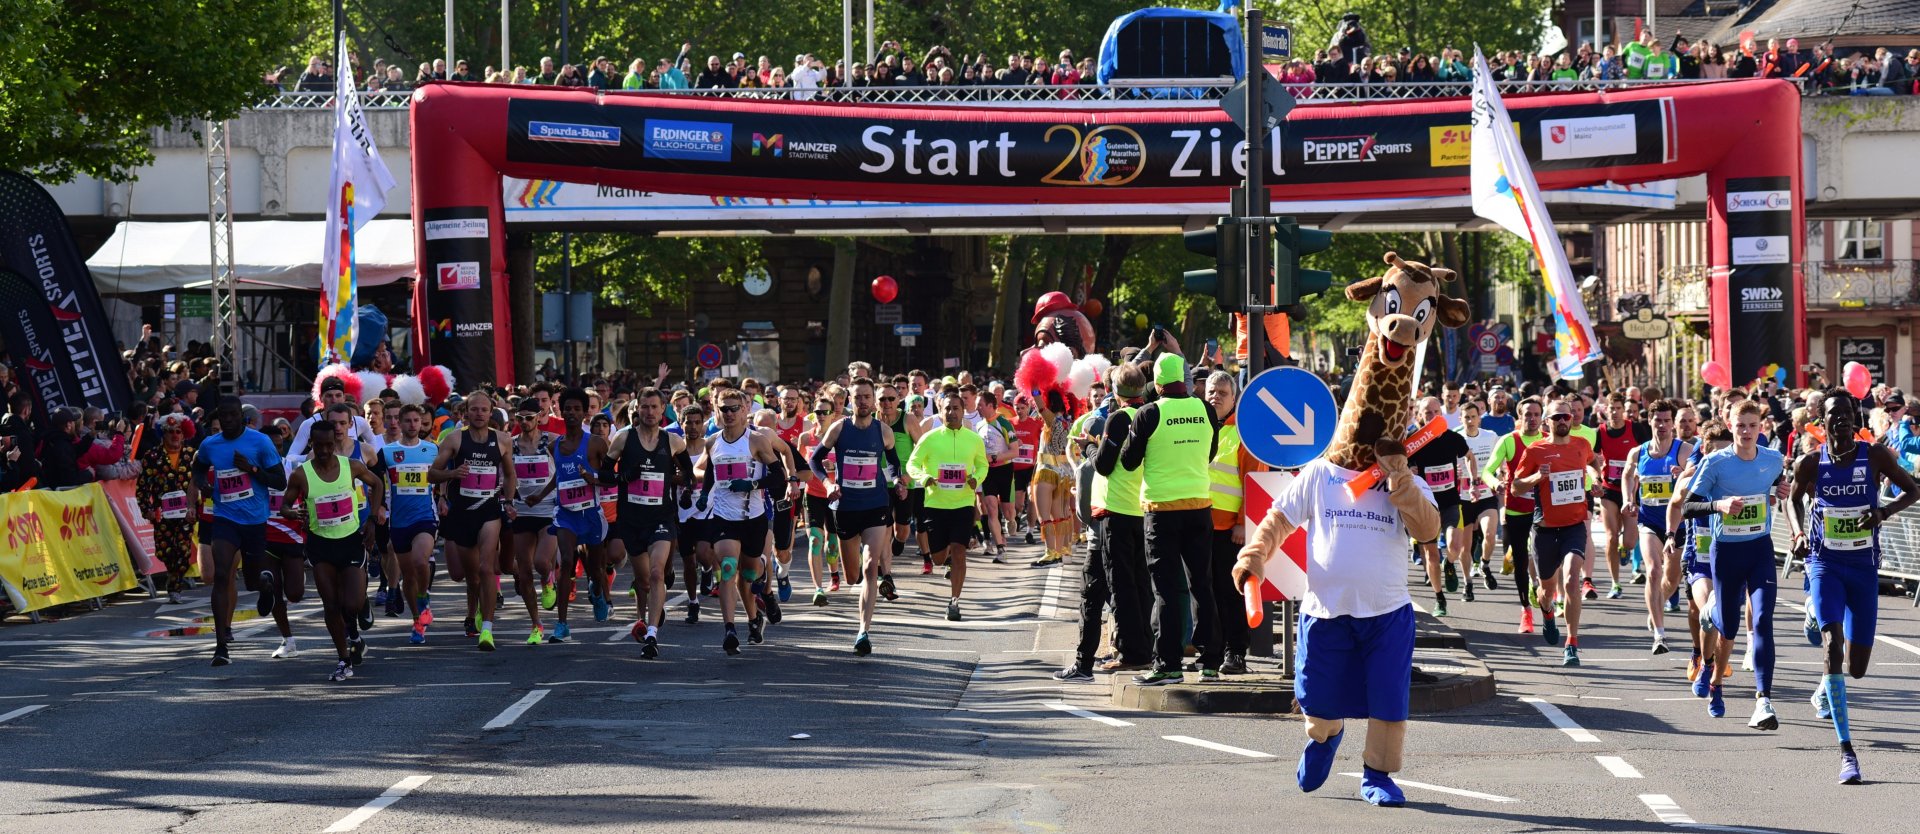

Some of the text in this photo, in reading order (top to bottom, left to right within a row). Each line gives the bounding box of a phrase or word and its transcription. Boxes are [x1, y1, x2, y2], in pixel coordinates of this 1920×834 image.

[540, 125, 609, 139] Sparda-Bank
[653, 127, 709, 142] ERDINGER
[653, 141, 723, 151] ALKOHOLFREI
[789, 142, 837, 153] MAINZER
[859, 125, 1017, 177] Start
[1106, 142, 1139, 152] Gutenberg
[1373, 143, 1412, 155] SPORTS
[788, 152, 829, 160] STADTWERKE
[1041, 124, 1147, 186] 20
[28, 233, 64, 302] SPORTS
[1741, 287, 1771, 301] SWR
[1742, 302, 1783, 310] FERNSEHEN
[456, 322, 493, 331] MAINZER
[1630, 322, 1662, 332] Hoi An
[18, 308, 42, 357] SPORTS
[1481, 337, 1496, 350] 30
[1166, 416, 1206, 426] ORDNER
[464, 459, 494, 467] balance
[858, 465, 862, 476] 7
[943, 470, 962, 480] 5941
[405, 472, 422, 483] 428
[1431, 471, 1450, 482] 5734
[222, 476, 243, 490] 5724
[1557, 479, 1578, 492] 5667
[1648, 483, 1663, 494] 453
[566, 488, 586, 500] 5731
[1822, 484, 1868, 496] SCHOTT
[1325, 508, 1395, 525] Sparda-Bank
